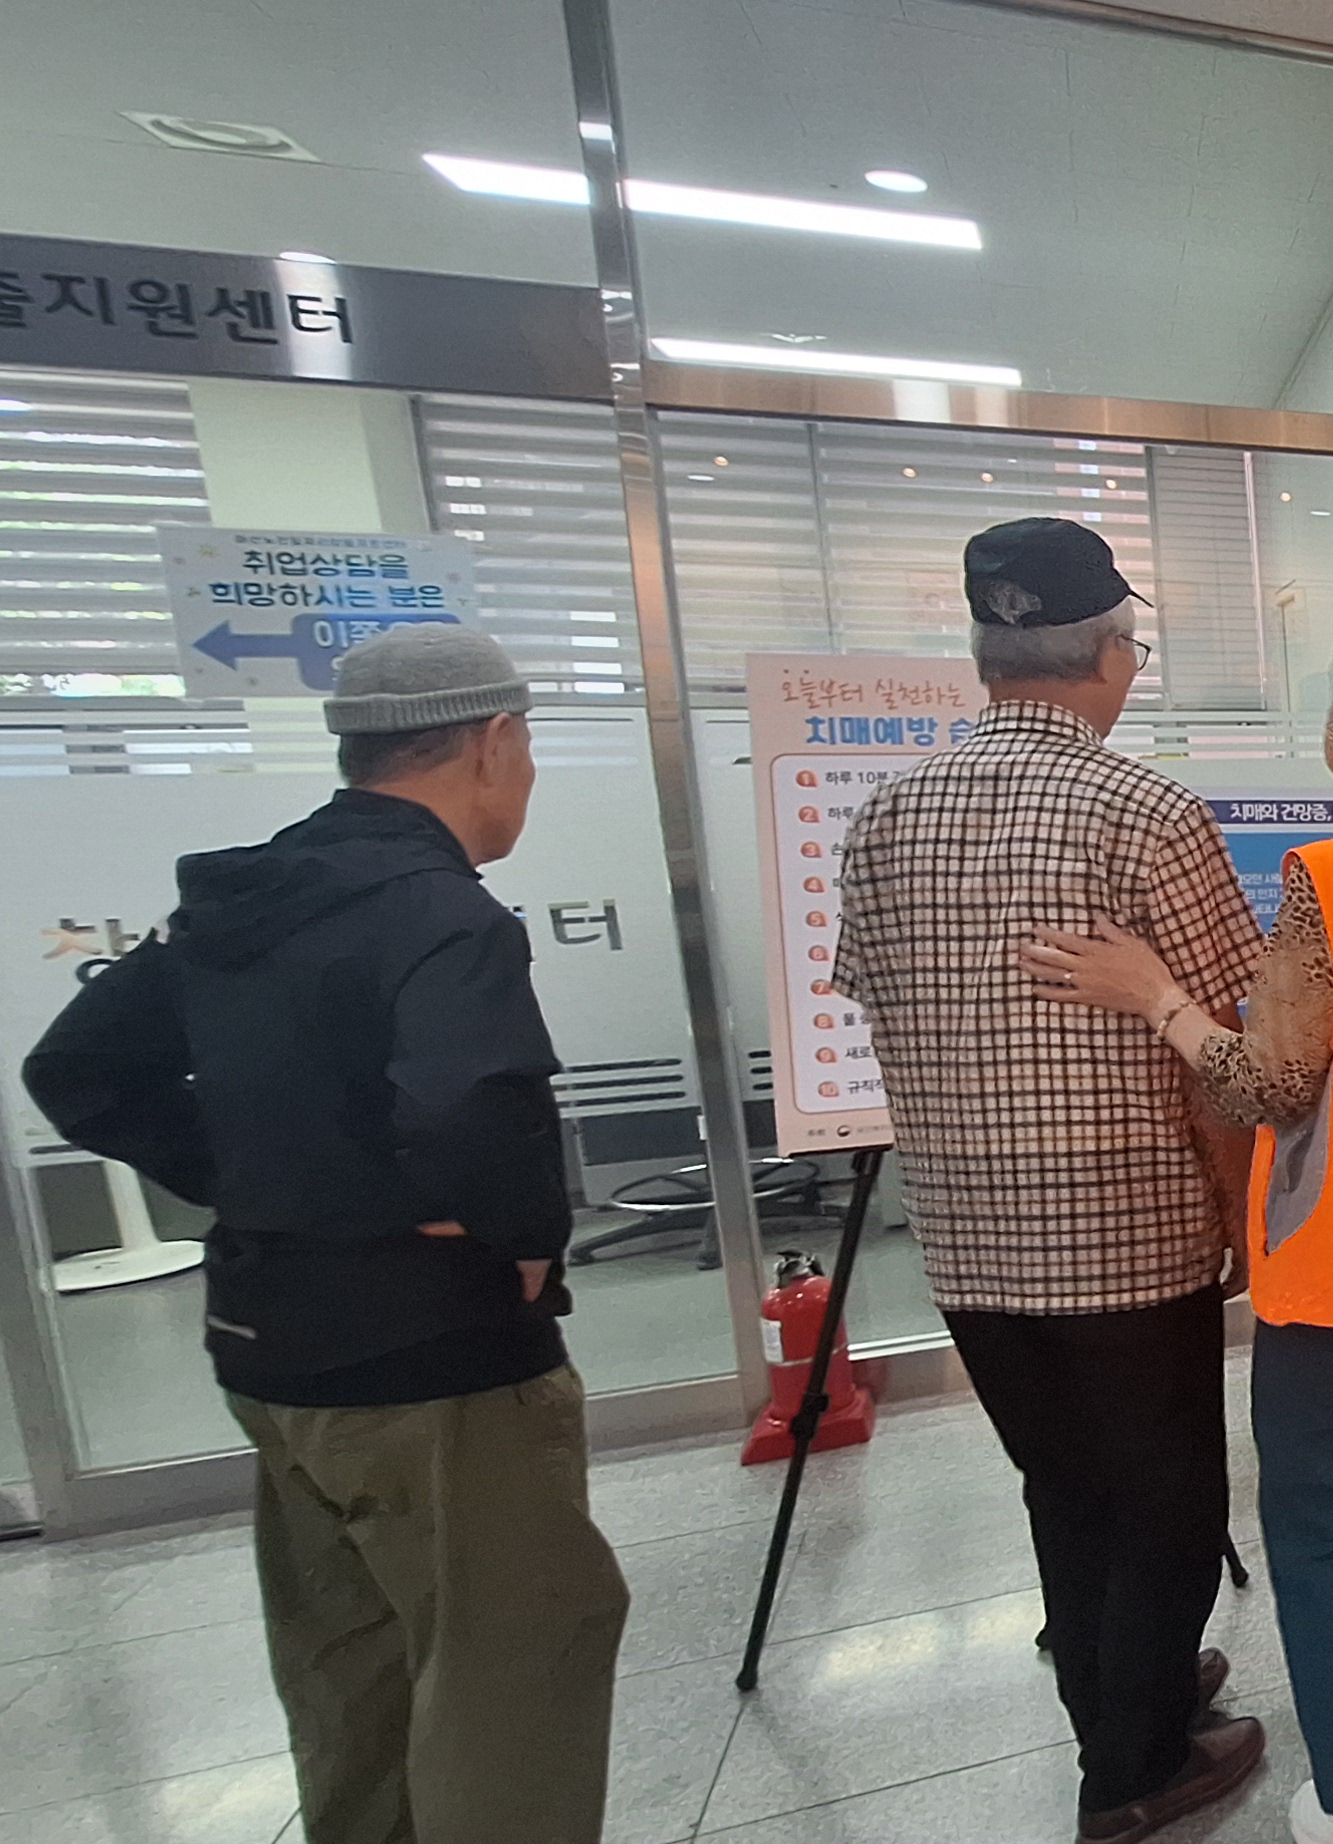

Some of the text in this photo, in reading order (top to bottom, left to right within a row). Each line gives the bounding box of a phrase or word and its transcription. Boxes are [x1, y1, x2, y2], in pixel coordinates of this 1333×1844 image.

[243, 549, 410, 580] 취업상담을
[208, 581, 446, 609] 희망하시는 분은
[781, 674, 966, 710] 오늘부터 실천하는
[805, 716, 939, 747] 치매예방
[826, 771, 852, 785] 하루
[1231, 803, 1278, 821] 치매와
[1281, 803, 1332, 821] 건망증,
